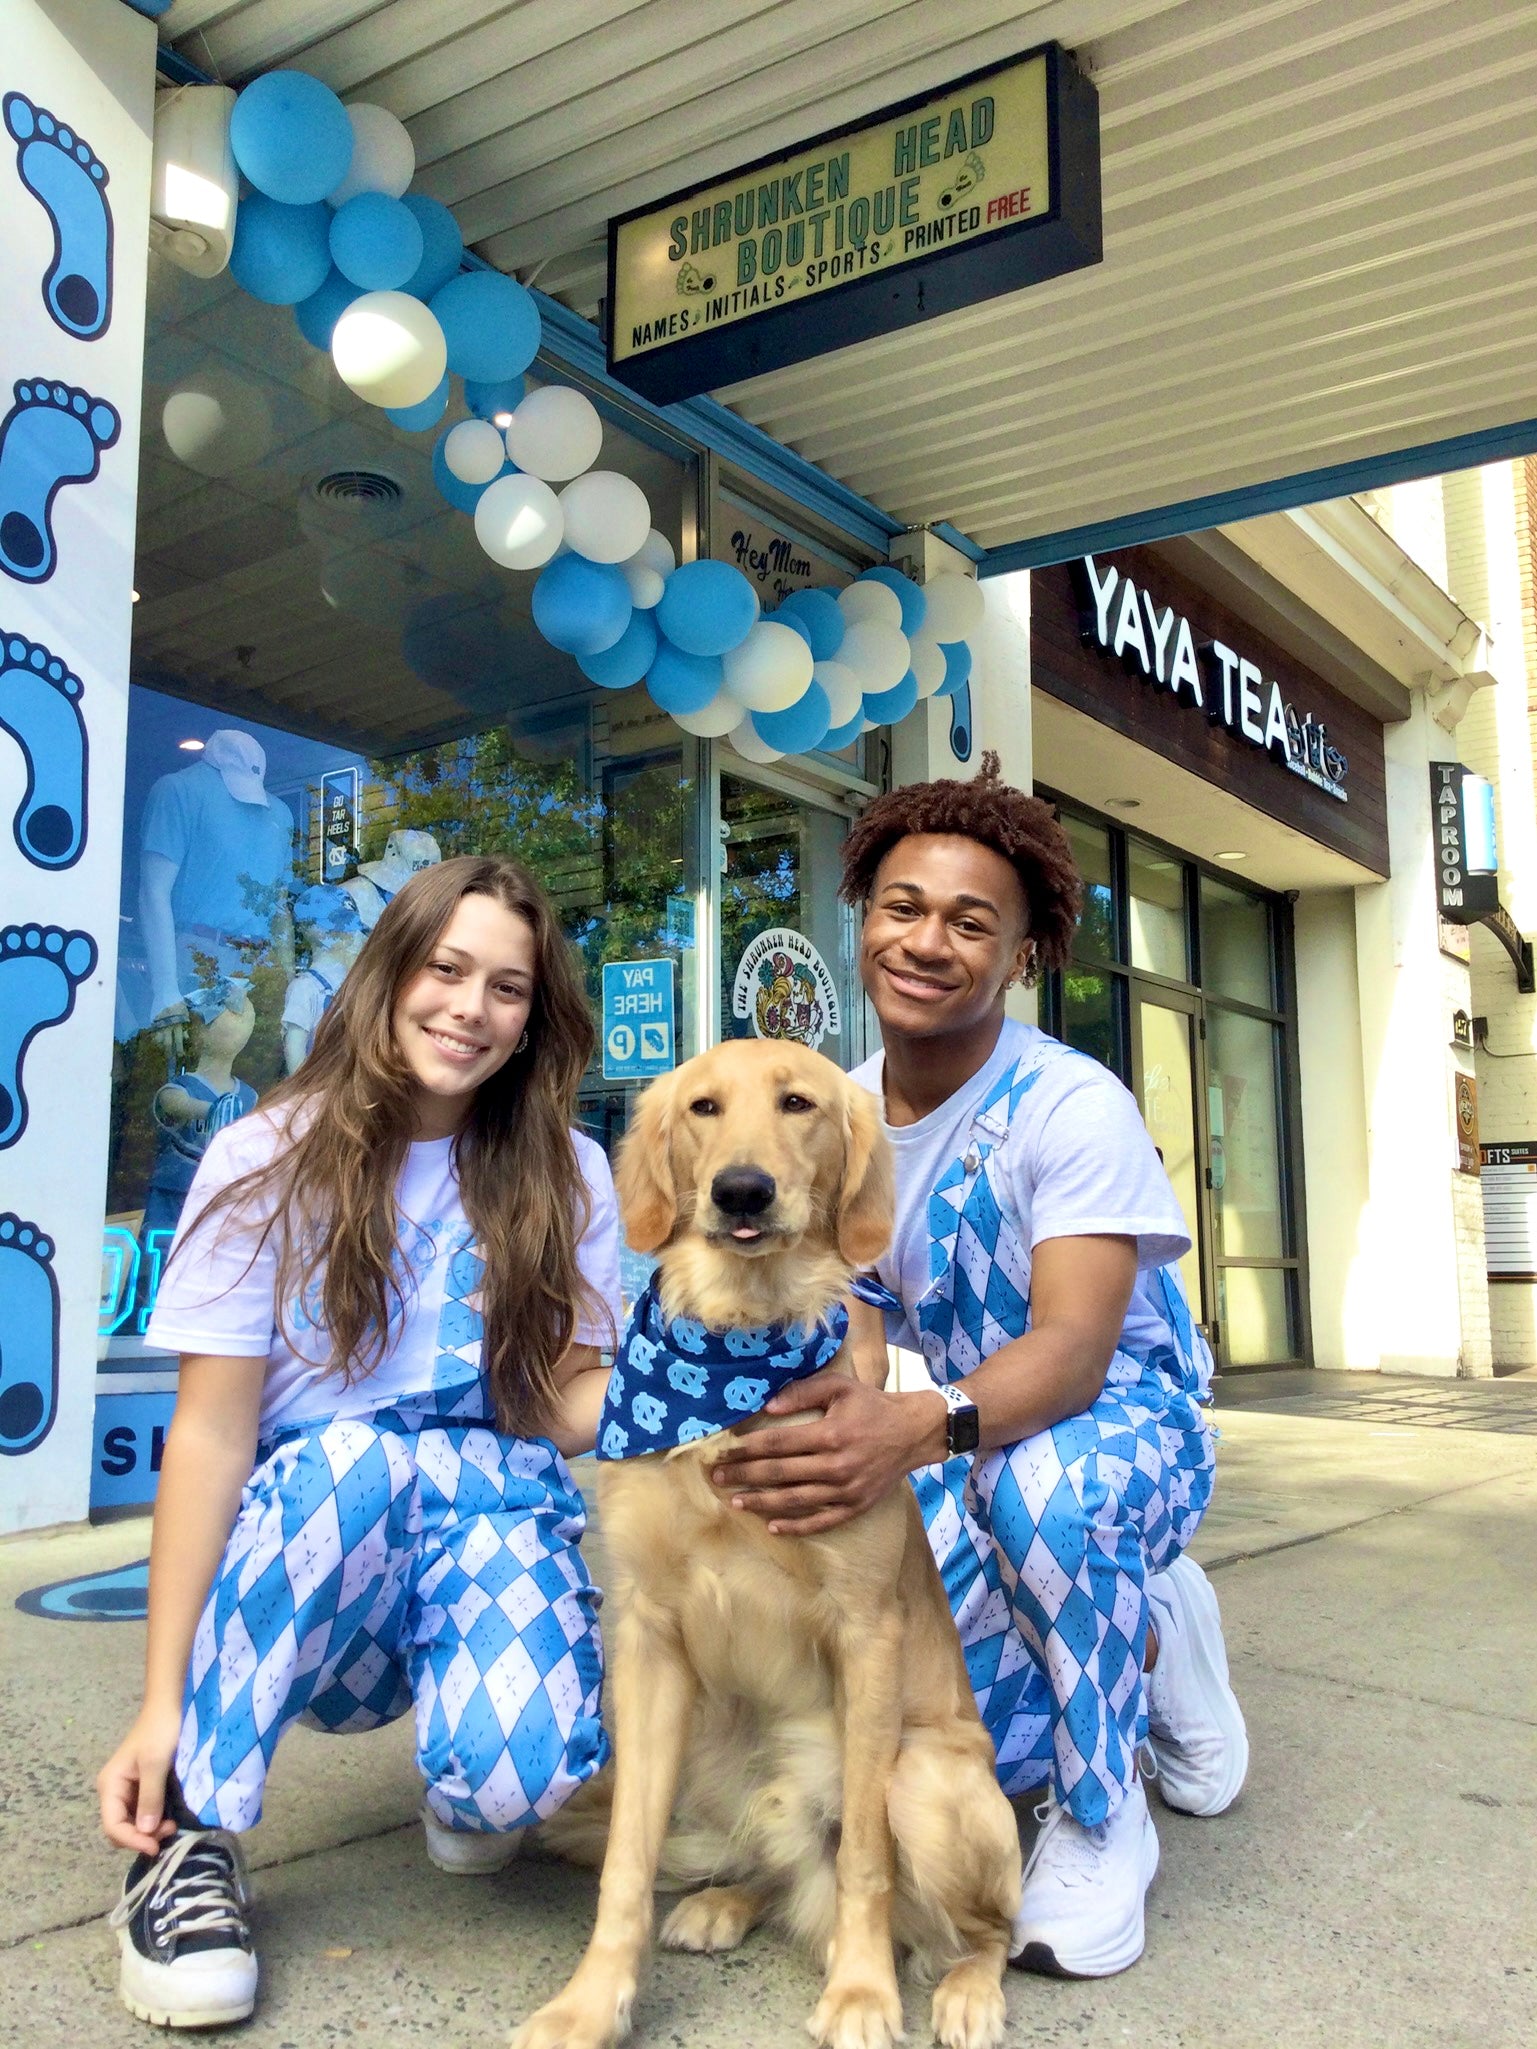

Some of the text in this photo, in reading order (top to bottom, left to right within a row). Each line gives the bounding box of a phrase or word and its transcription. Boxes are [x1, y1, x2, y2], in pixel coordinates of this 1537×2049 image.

[668, 96, 995, 262] SHRUNKEN HEAD
[632, 187, 1032, 349] NAMES INITIALS SPORTS PRINTED FREE
[737, 176, 921, 287] BOUTIQUE
[731, 530, 811, 582] Hey Mom
[1084, 555, 1203, 707] YAYA
[1213, 639, 1292, 762] TEA
[326, 822, 350, 837] HEELS
[331, 808, 346, 822] TAR
[333, 795, 344, 808] GO
[1438, 765, 1464, 907] TAPROOM
[738, 983, 748, 1012] THE
[743, 934, 784, 980] SHRUNKEN
[788, 935, 812, 960] HEAD
[813, 960, 838, 1028] BOUTIQUE
[1480, 1149, 1511, 1165] OFTS
